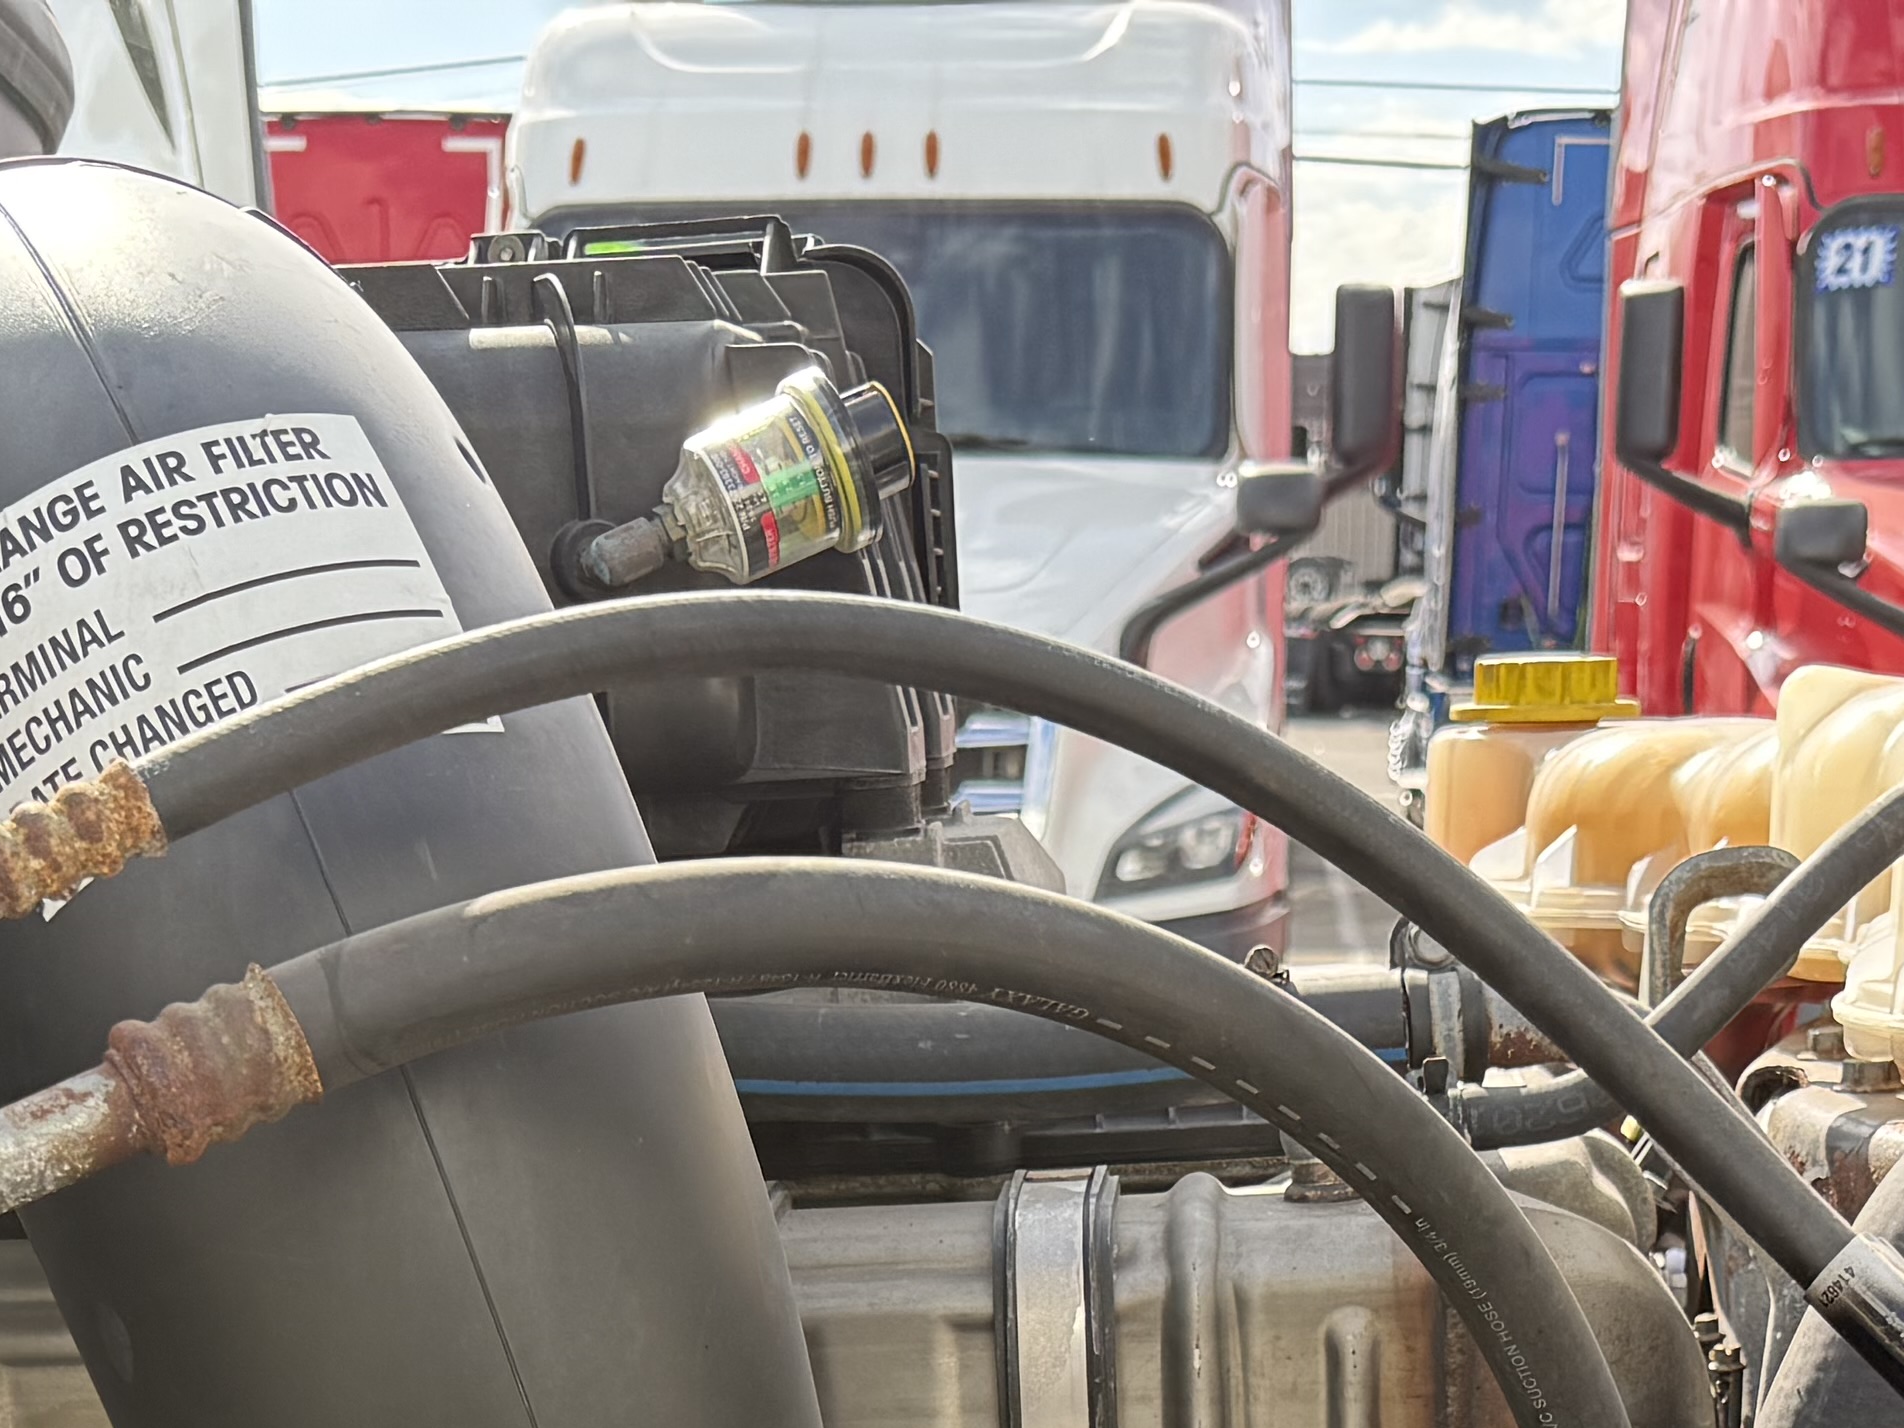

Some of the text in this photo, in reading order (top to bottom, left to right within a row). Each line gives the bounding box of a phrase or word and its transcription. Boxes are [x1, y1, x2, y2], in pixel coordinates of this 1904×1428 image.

[789, 416, 811, 445] RESET
[118, 450, 196, 503] AIR
[202, 426, 332, 476] FILTER
[56, 538, 111, 587] OF
[116, 472, 389, 560] RESTRICTION
[28, 670, 258, 804] ATE CHANGED
[981, 986, 1090, 1020] GALAXY
[1427, 1227, 1449, 1254] 3/4
[1446, 1250, 1489, 1302] (19mm)
[1477, 1301, 1512, 1347] HOSE
[1508, 1345, 1547, 1411] SUCTION
